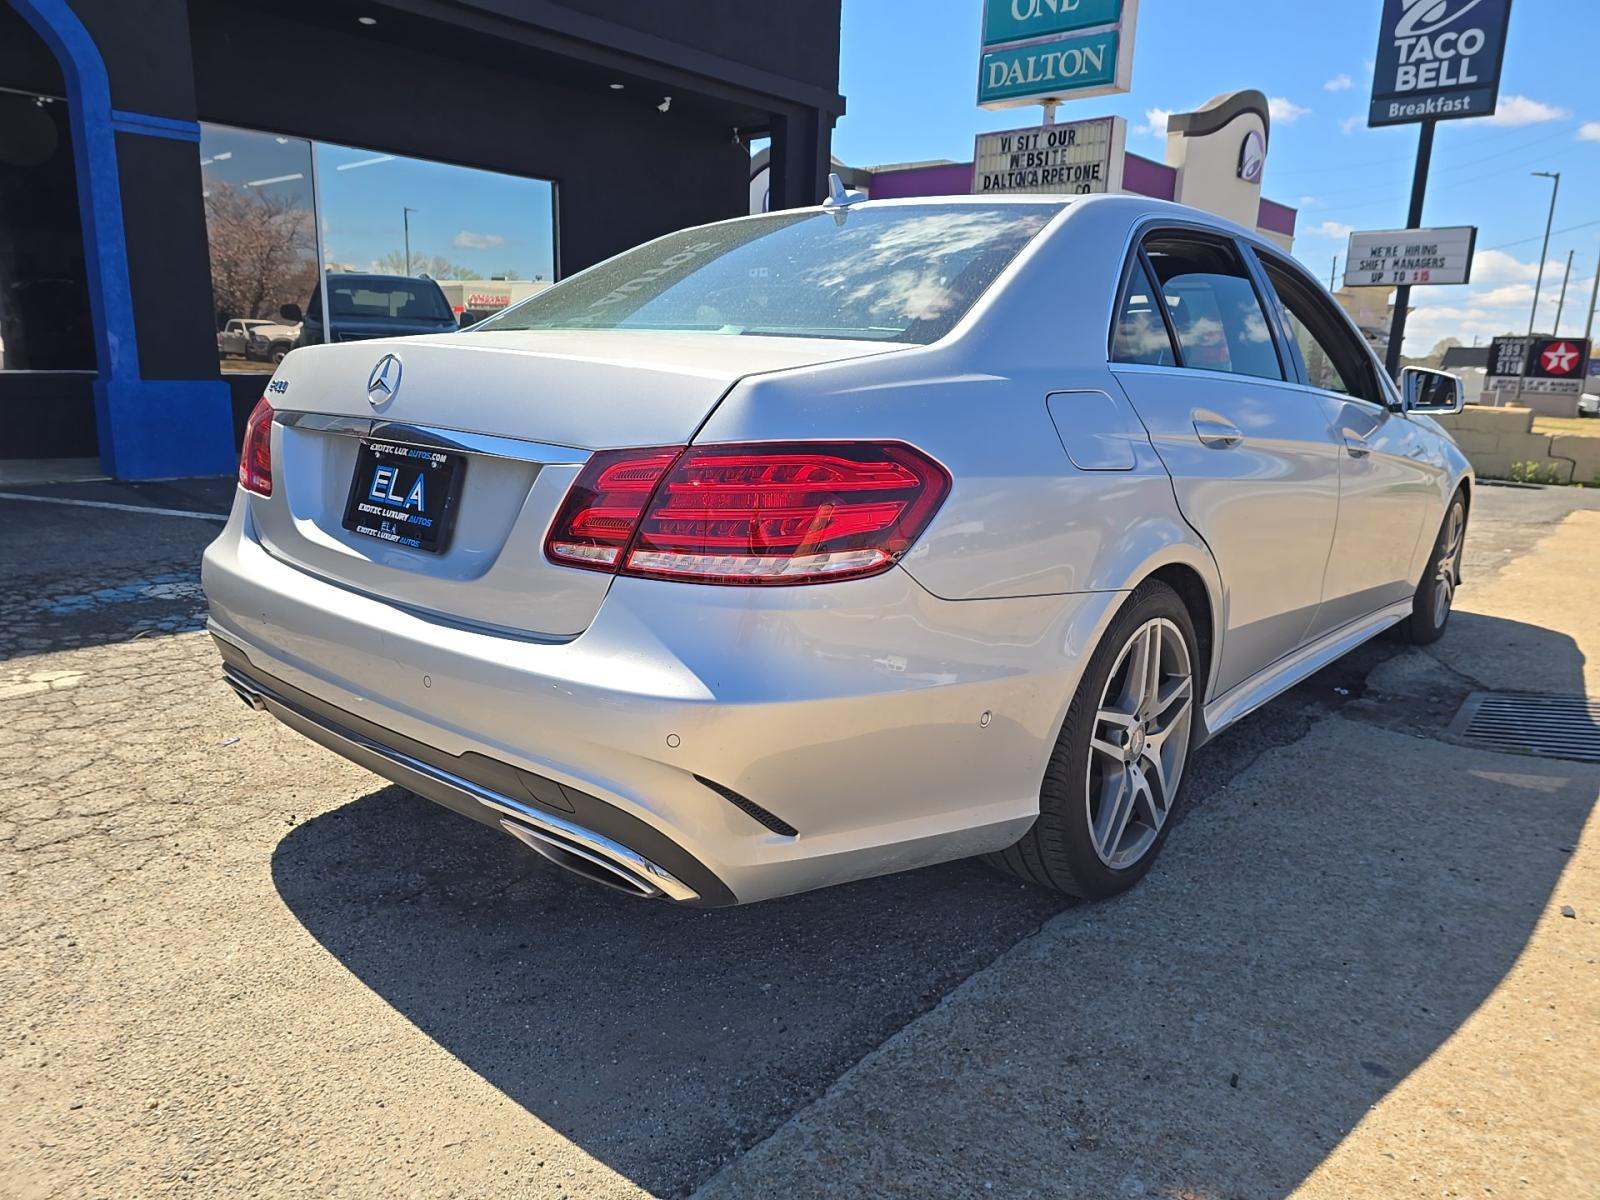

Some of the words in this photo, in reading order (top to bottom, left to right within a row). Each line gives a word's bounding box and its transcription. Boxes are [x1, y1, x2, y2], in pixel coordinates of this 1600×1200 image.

[1394, 28, 1486, 64] TACO
[988, 44, 1106, 89] DALTON
[1394, 57, 1478, 92] BELL
[1389, 95, 1471, 118] Breakfast
[1048, 130, 1076, 147] OUR
[1010, 149, 1067, 169] WEBSITE
[1370, 245, 1398, 258] WE'RE
[1404, 244, 1438, 256] HIRING
[1359, 259, 1386, 271] SHIFT
[1392, 257, 1446, 270] MANAGERS
[1370, 272, 1384, 283] UP
[1393, 271, 1406, 282] TO
[370, 443, 394, 454] EXOTIC
[394, 446, 408, 456] LUX
[368, 465, 425, 512] ELA
[358, 502, 382, 515] EXOTIC
[382, 508, 409, 522] LUXURY
[408, 515, 433, 527] AUTOS
[356, 525, 379, 537] EXOTIC
[378, 530, 401, 543] LUXURY
[400, 535, 422, 548] AUTOS
